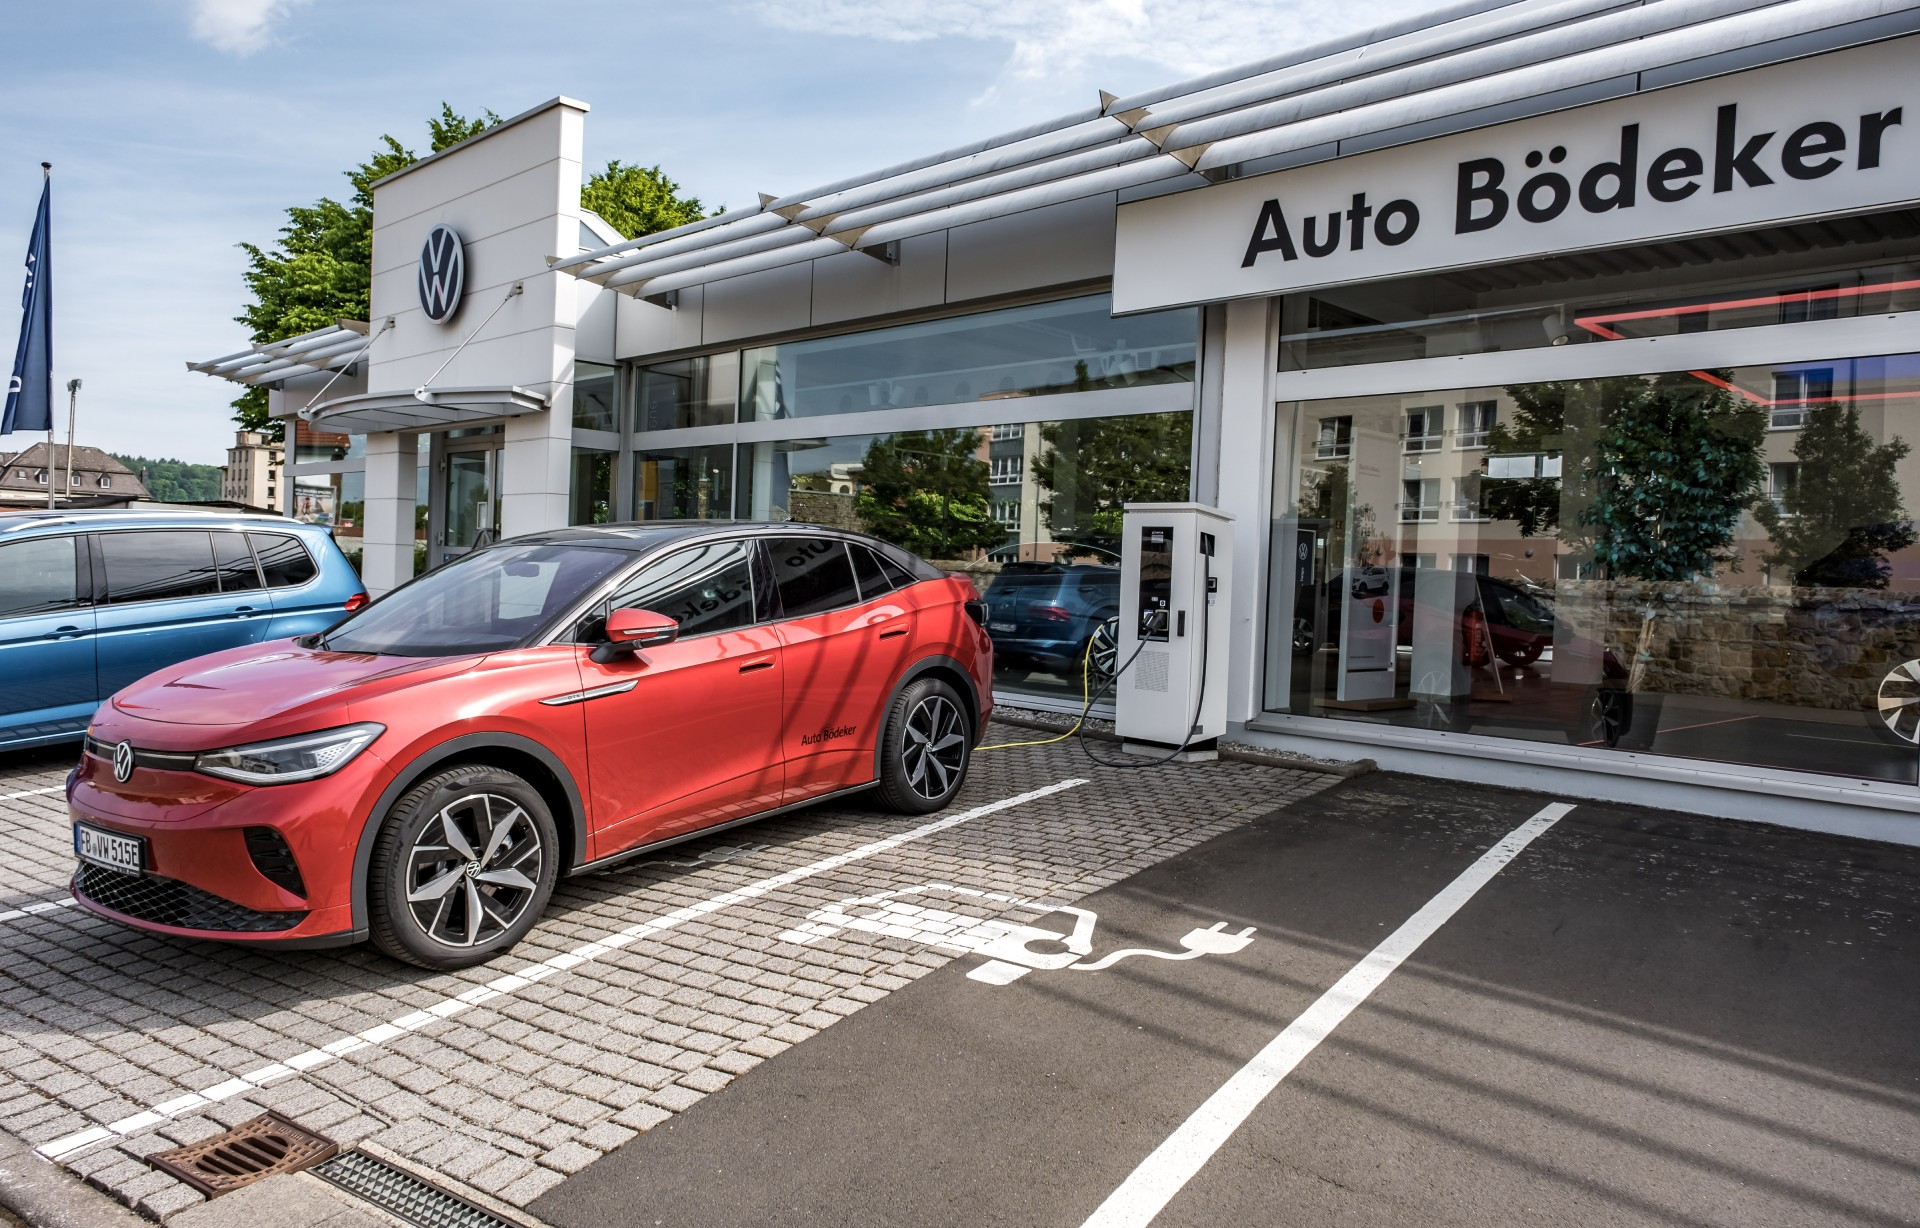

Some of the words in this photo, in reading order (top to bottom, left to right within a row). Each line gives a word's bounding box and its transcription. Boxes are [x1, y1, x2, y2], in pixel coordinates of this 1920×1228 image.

[1241, 192, 1420, 268] Auto
[1455, 104, 1902, 235] Bödeker
[1363, 511, 1377, 522] No
[801, 734, 821, 746] Auto
[823, 725, 857, 741] Bödeker
[80, 829, 91, 854] FB
[96, 834, 109, 860] VW
[111, 837, 140, 867] 515E
